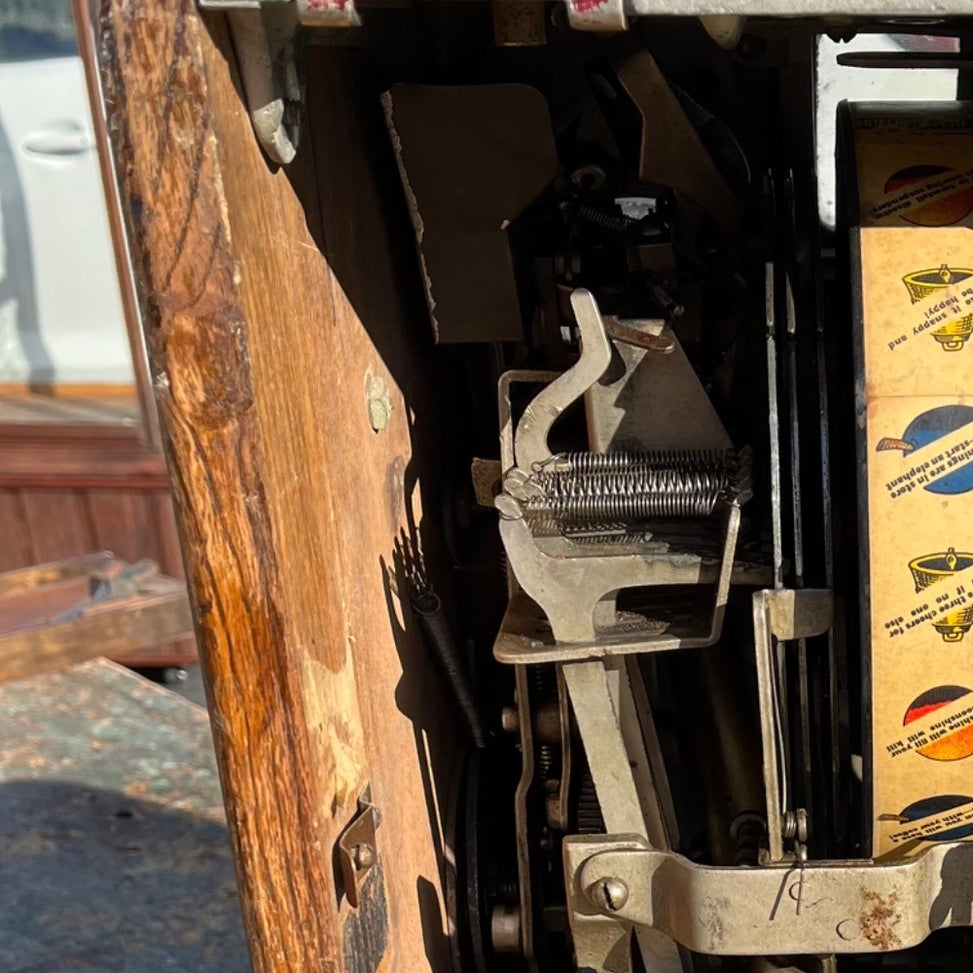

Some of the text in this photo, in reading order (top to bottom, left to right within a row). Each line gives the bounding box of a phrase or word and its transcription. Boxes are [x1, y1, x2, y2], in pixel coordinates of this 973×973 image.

[923, 295, 959, 319] happy!
[950, 304, 962, 314] it
[911, 311, 948, 335] snappy
[886, 333, 907, 351] and
[929, 453, 944, 465] an
[884, 461, 930, 491] elephant
[928, 463, 946, 477] are
[915, 473, 930, 484] in
[889, 480, 916, 499] store
[955, 584, 965, 596] if
[934, 592, 949, 604] no
[938, 595, 966, 613] three
[909, 603, 929, 616] one
[883, 615, 904, 629] else
[904, 609, 937, 630] cheers
[888, 625, 904, 638] for
[906, 730, 926, 743] will
[928, 728, 947, 741] will
[885, 739, 904, 752] kill
[913, 737, 928, 748] fill
[890, 742, 913, 758] your
[919, 818, 941, 830] your
[944, 816, 963, 827] you
[924, 824, 943, 834] will
[900, 830, 925, 843] have
